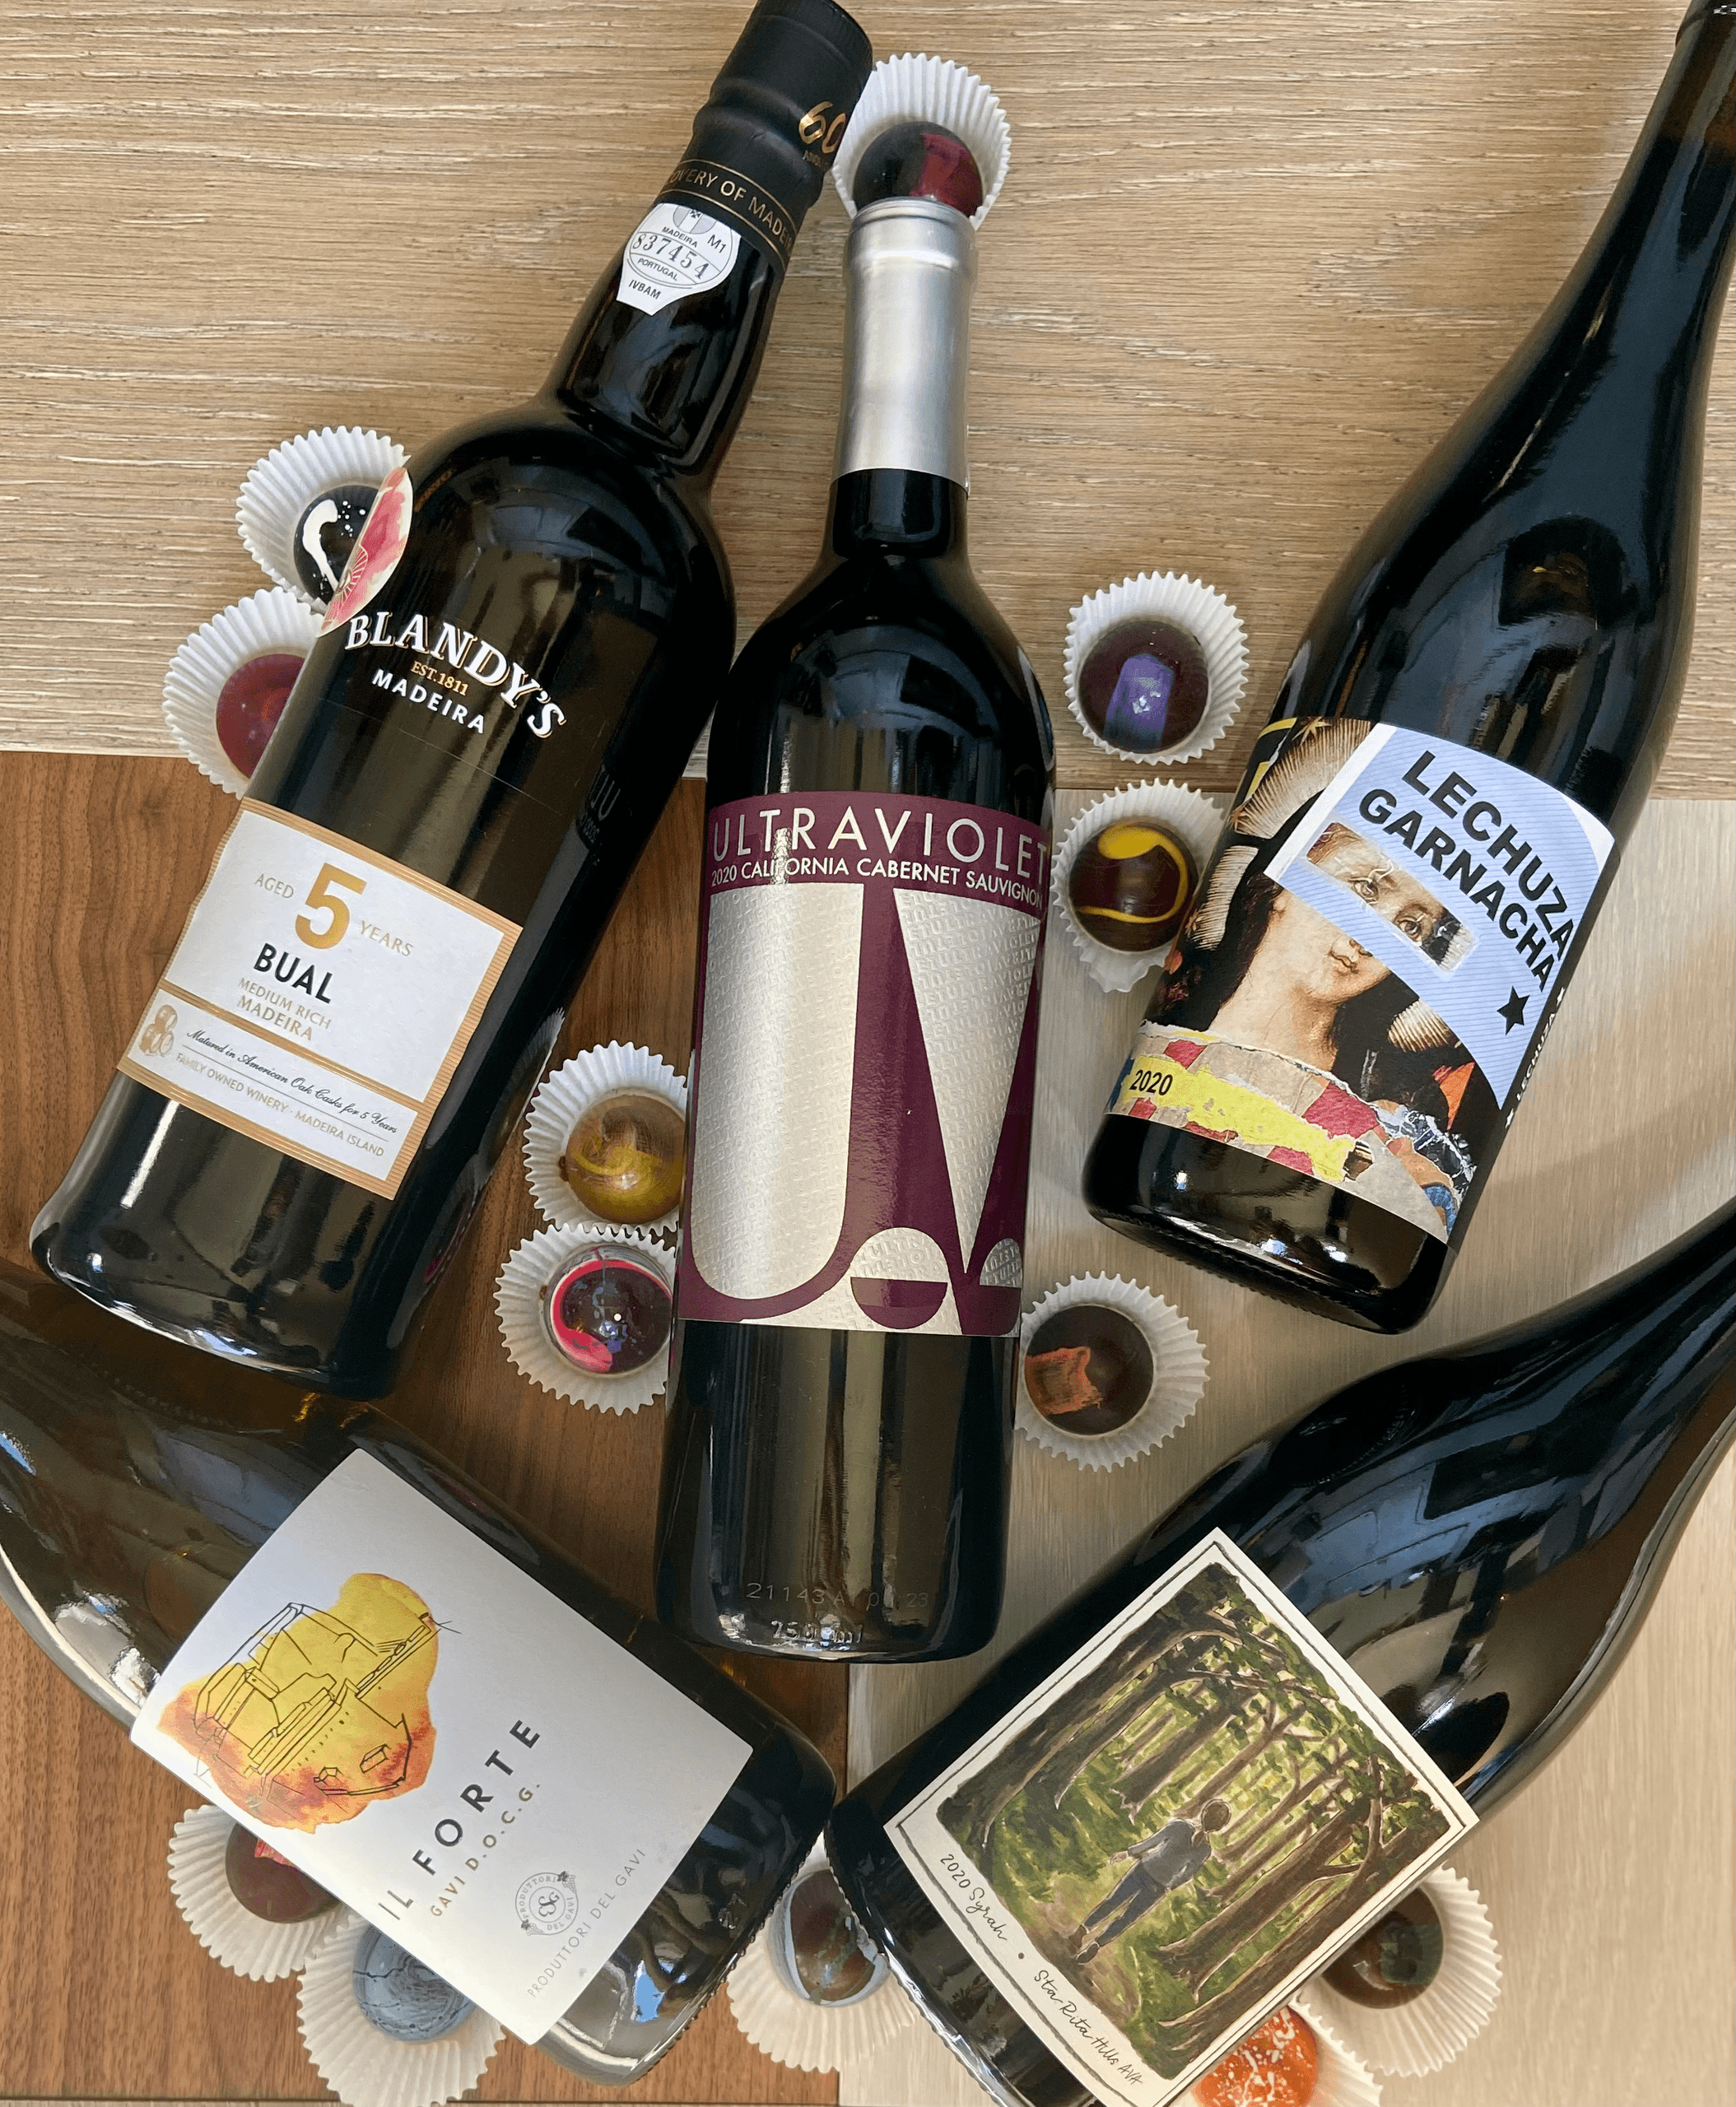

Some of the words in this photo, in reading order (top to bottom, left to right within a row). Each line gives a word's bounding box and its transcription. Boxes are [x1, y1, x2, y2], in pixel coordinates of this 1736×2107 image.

[670, 169, 719, 188] OVERY
[720, 180, 747, 201] OF
[632, 233, 710, 280] 837454
[662, 226, 698, 249] MADEIRA
[707, 234, 727, 253] M1
[628, 279, 662, 300] IVBAM
[637, 258, 678, 281] PORTUGAL
[344, 611, 567, 738] BLANDY'S
[372, 668, 485, 734] MADEIRA
[714, 805, 1048, 886] ULTRAVIOLET
[1401, 750, 1575, 961] LECHUZA
[254, 873, 295, 899] AGED
[295, 862, 367, 950] 5
[359, 919, 414, 957] YEARS
[711, 864, 738, 887] 2020
[741, 857, 849, 880] CALIFORNIA
[856, 858, 961, 886] CABERNET
[966, 870, 1043, 911] SAUVIGNON
[1358, 788, 1555, 993] GARNACHA
[253, 942, 333, 1005] BUAL
[236, 994, 313, 1042] MADEIRA
[237, 977, 294, 1012] MEDIUM
[296, 1004, 333, 1030] RICH
[175, 1052, 207, 1073] FAMILY
[206, 1068, 244, 1092] OWNED
[246, 1086, 289, 1113] WINERY
[294, 1110, 344, 1140] MADEIRA
[346, 1133, 385, 1156] ISLAND
[186, 1030, 230, 1053] Matured
[225, 1048, 236, 1058] in
[237, 1054, 289, 1083] American
[291, 1077, 315, 1095] Oak
[314, 1089, 342, 1109] Casks
[338, 1103, 361, 1114] for
[359, 1111, 370, 1119] 5
[370, 1112, 398, 1133] Years
[1129, 1069, 1174, 1097] 2020
[377, 1889, 414, 1921] IL
[412, 1719, 541, 1877] FORTE
[430, 1875, 466, 1918] GAVI
[519, 1875, 556, 1919] PRODUTTORI
[527, 1921, 592, 1998] PRODUTTORI
[589, 1891, 616, 1920] DEL
[614, 1849, 646, 1887] GAVI
[547, 1921, 565, 1931] DEL
[565, 1896, 575, 1920] GAVI
[940, 1853, 971, 1889] 2020
[966, 1886, 1008, 1942] Syrah
[1034, 1969, 1063, 2004] Sta
[1059, 2000, 1094, 2039] Rita
[1091, 2036, 1119, 2066] Hills
[1116, 2063, 1144, 2086] AVA
